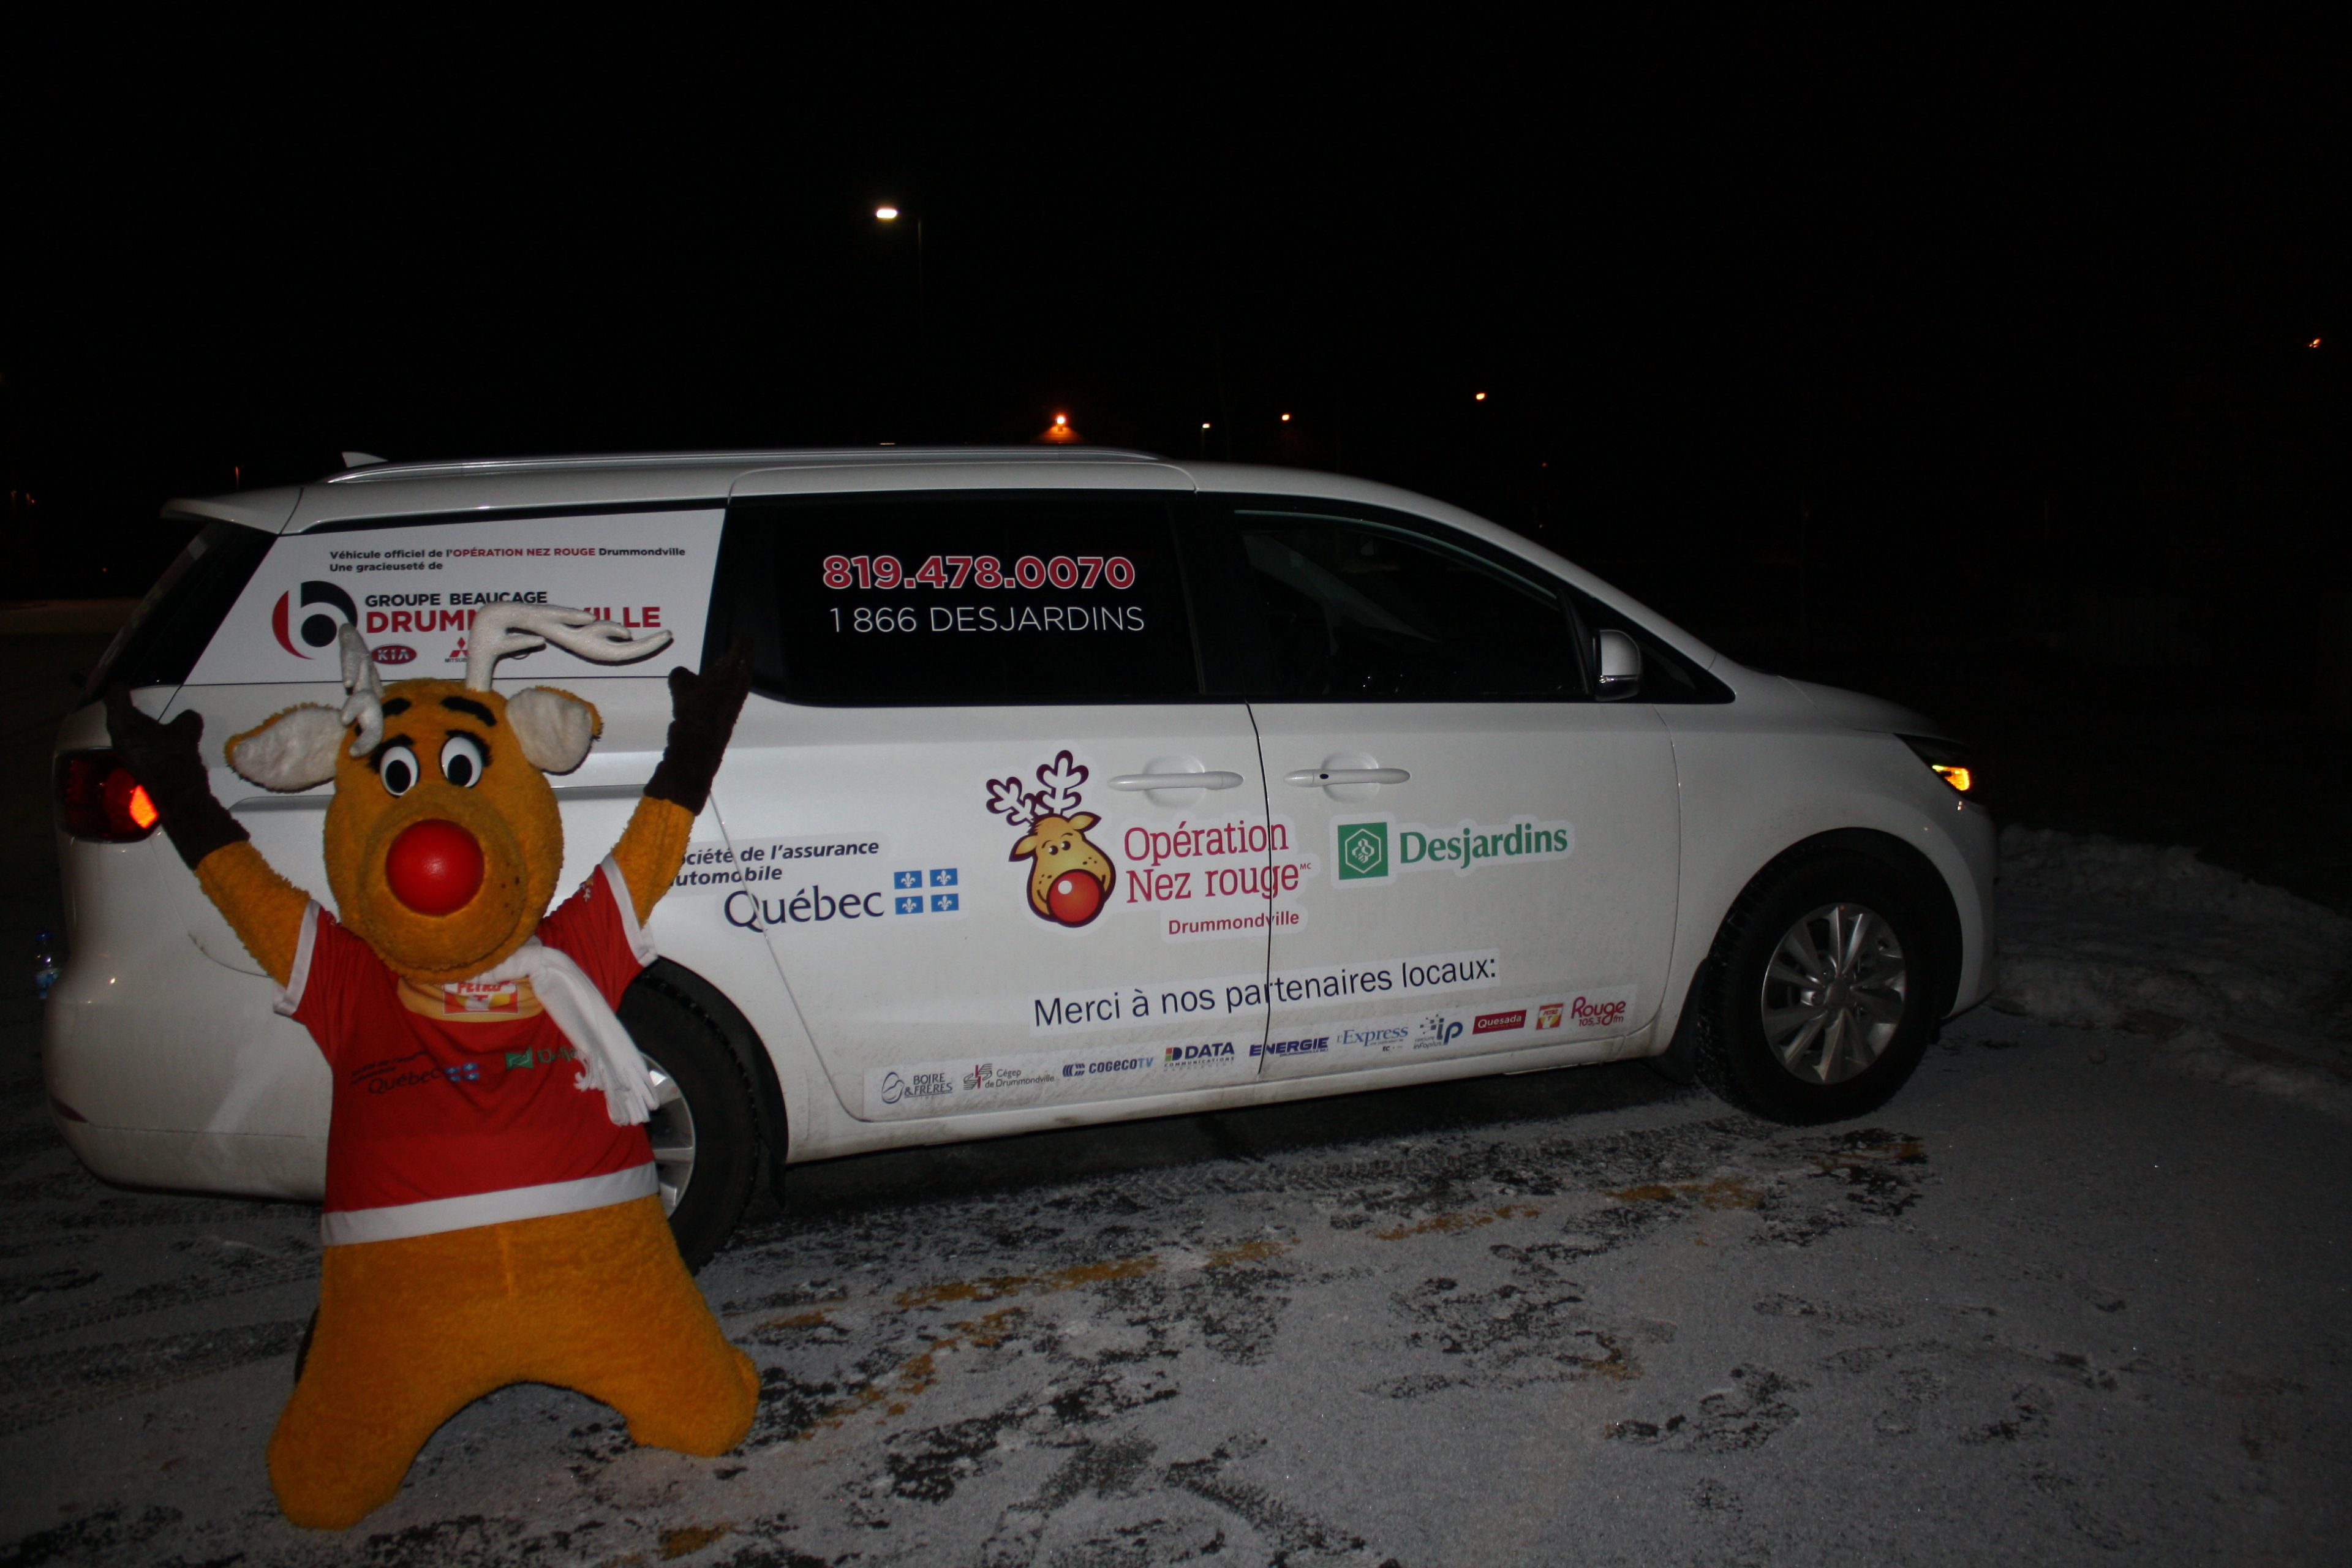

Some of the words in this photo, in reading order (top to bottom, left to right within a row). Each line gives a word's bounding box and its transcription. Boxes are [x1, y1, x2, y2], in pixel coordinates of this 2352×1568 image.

[330, 549, 382, 559] Véhicule
[384, 548, 425, 558] officiel
[428, 548, 443, 557] de
[446, 546, 524, 557] l'OPÉRATION
[526, 548, 551, 557] NEZ
[553, 547, 596, 557] ROUGE
[598, 546, 685, 556] Drummondville
[329, 562, 353, 572] Une
[355, 560, 426, 573] gracieuseté
[428, 562, 443, 571] de
[822, 554, 1136, 589] 819.478.0070
[365, 593, 441, 608] GROUPE
[450, 591, 548, 605] BEAUCAGE
[367, 606, 661, 633] DRUMILLE
[829, 608, 840, 632] 1
[853, 607, 918, 632] 866
[930, 606, 1145, 631] DESJARDINS
[377, 649, 410, 661] KIA
[681, 846, 733, 866] ciété
[740, 846, 765, 862] de
[771, 840, 880, 861] l'assurance
[1125, 821, 1289, 867] Opération
[1400, 824, 1567, 869] Desjardins
[669, 865, 783, 888] utomobile
[1126, 869, 1191, 903] Nez
[1205, 865, 1300, 900] rouge
[724, 884, 885, 933] Québec
[1168, 911, 1300, 935] Drummondville
[1034, 992, 1121, 1027] Merci
[1131, 987, 1150, 1017] à
[1161, 989, 1215, 1014] nos
[1226, 968, 1392, 1014] partenaires
[1403, 959, 1496, 989] locaux:
[1477, 1014, 1522, 1029] Quesada
[1570, 996, 1627, 1026] Rouge
[1185, 1042, 1235, 1060] DATA
[913, 1073, 946, 1085] BOIRE
[985, 1079, 995, 1088] de
[995, 1074, 1055, 1088] Drummondville
[996, 1069, 1022, 1079] Cégep
